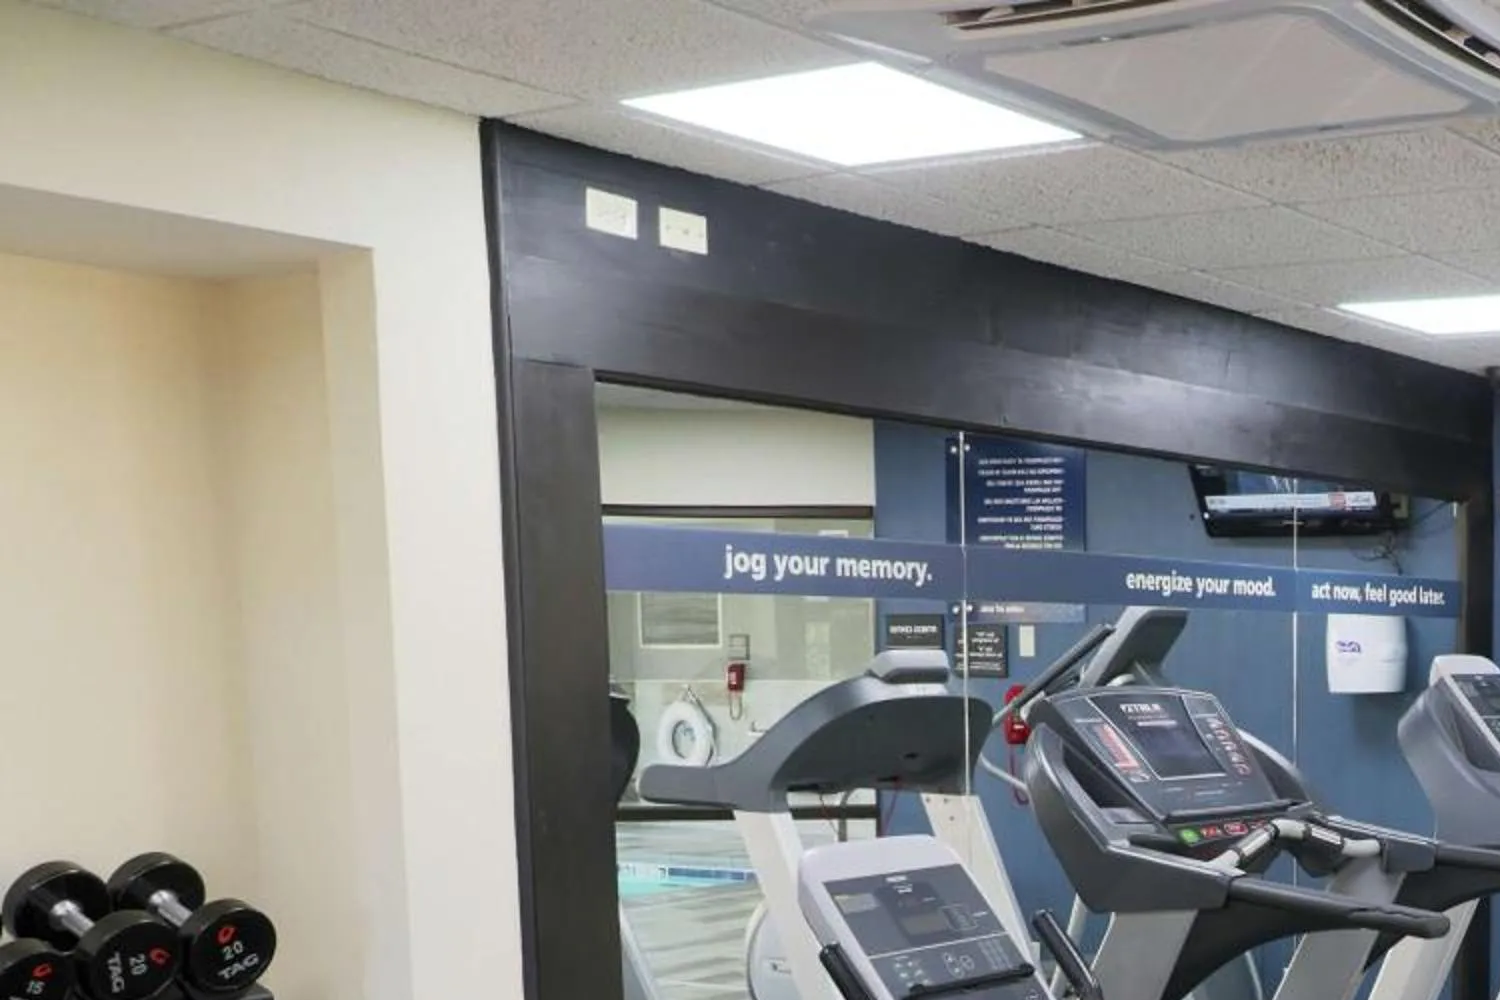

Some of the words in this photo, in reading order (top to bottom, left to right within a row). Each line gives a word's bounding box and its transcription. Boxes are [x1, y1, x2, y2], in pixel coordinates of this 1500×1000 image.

[724, 544, 766, 581] jog
[773, 553, 830, 581] your
[835, 557, 932, 587] memory.
[1125, 569, 1193, 597] energize
[1195, 575, 1231, 598] your
[1233, 576, 1277, 597] mood.
[1312, 582, 1331, 600] act
[1333, 585, 1362, 604] now,
[1365, 582, 1387, 602] feel
[1389, 586, 1417, 607] good
[1419, 586, 1446, 605] later.
[129, 953, 148, 976] 20
[222, 943, 244, 960] 20
[106, 952, 125, 993] TAG
[217, 953, 260, 980] TAG
